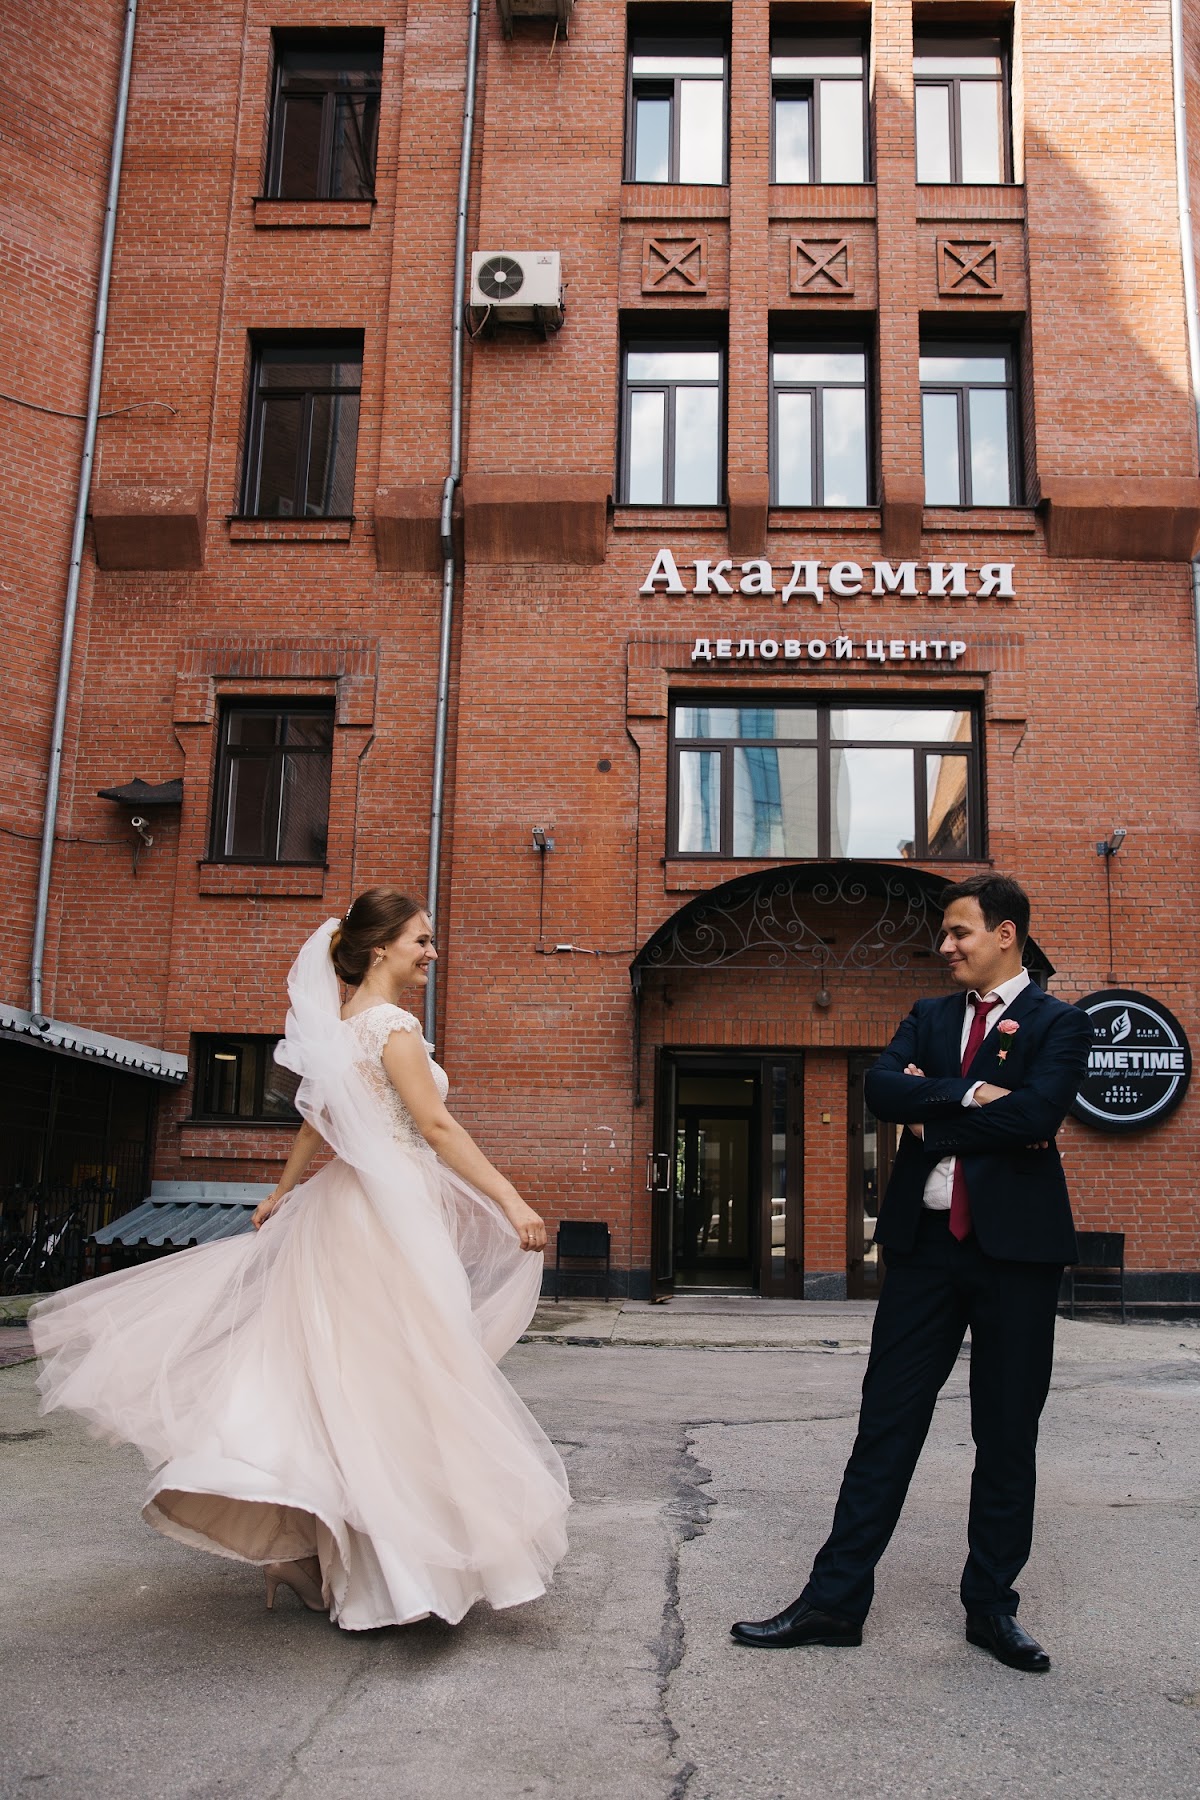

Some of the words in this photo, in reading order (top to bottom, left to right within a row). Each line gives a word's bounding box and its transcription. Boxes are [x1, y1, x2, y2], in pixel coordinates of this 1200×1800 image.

[638, 548, 1017, 606] Академия
[691, 635, 854, 663] ДЕЛОВОЙ
[866, 640, 967, 663] ЦЕНТР
[1088, 1051, 1185, 1070] IMETIME
[1088, 1068, 1103, 1078] good
[1103, 1069, 1121, 1079] coffee
[1124, 1069, 1141, 1079] fresh
